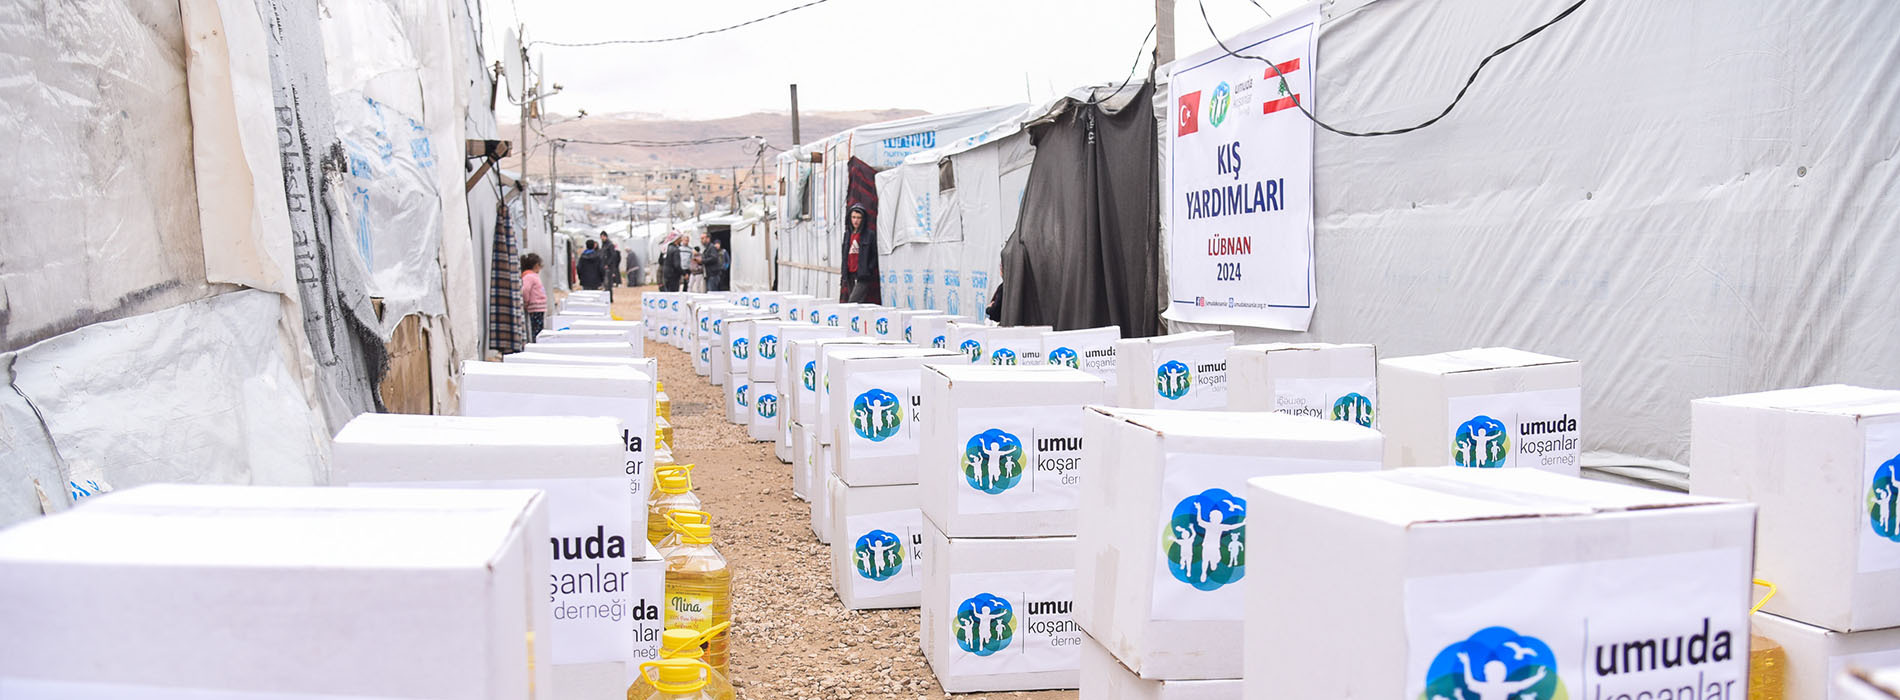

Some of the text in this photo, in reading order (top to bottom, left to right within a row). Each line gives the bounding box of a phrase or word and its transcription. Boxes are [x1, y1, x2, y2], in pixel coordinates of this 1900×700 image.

[1217, 141, 1242, 180] KIŞ
[1186, 178, 1284, 220] YARDIMLARI
[1208, 233, 1252, 256] LÜBNAN
[1217, 262, 1242, 281] 2024
[1520, 413, 1577, 436] umuda
[1520, 434, 1578, 456] koşanlar
[1541, 453, 1576, 466] derneği
[554, 600, 627, 621] derneği
[671, 596, 702, 612] Nina
[1596, 617, 1733, 676] umuda
